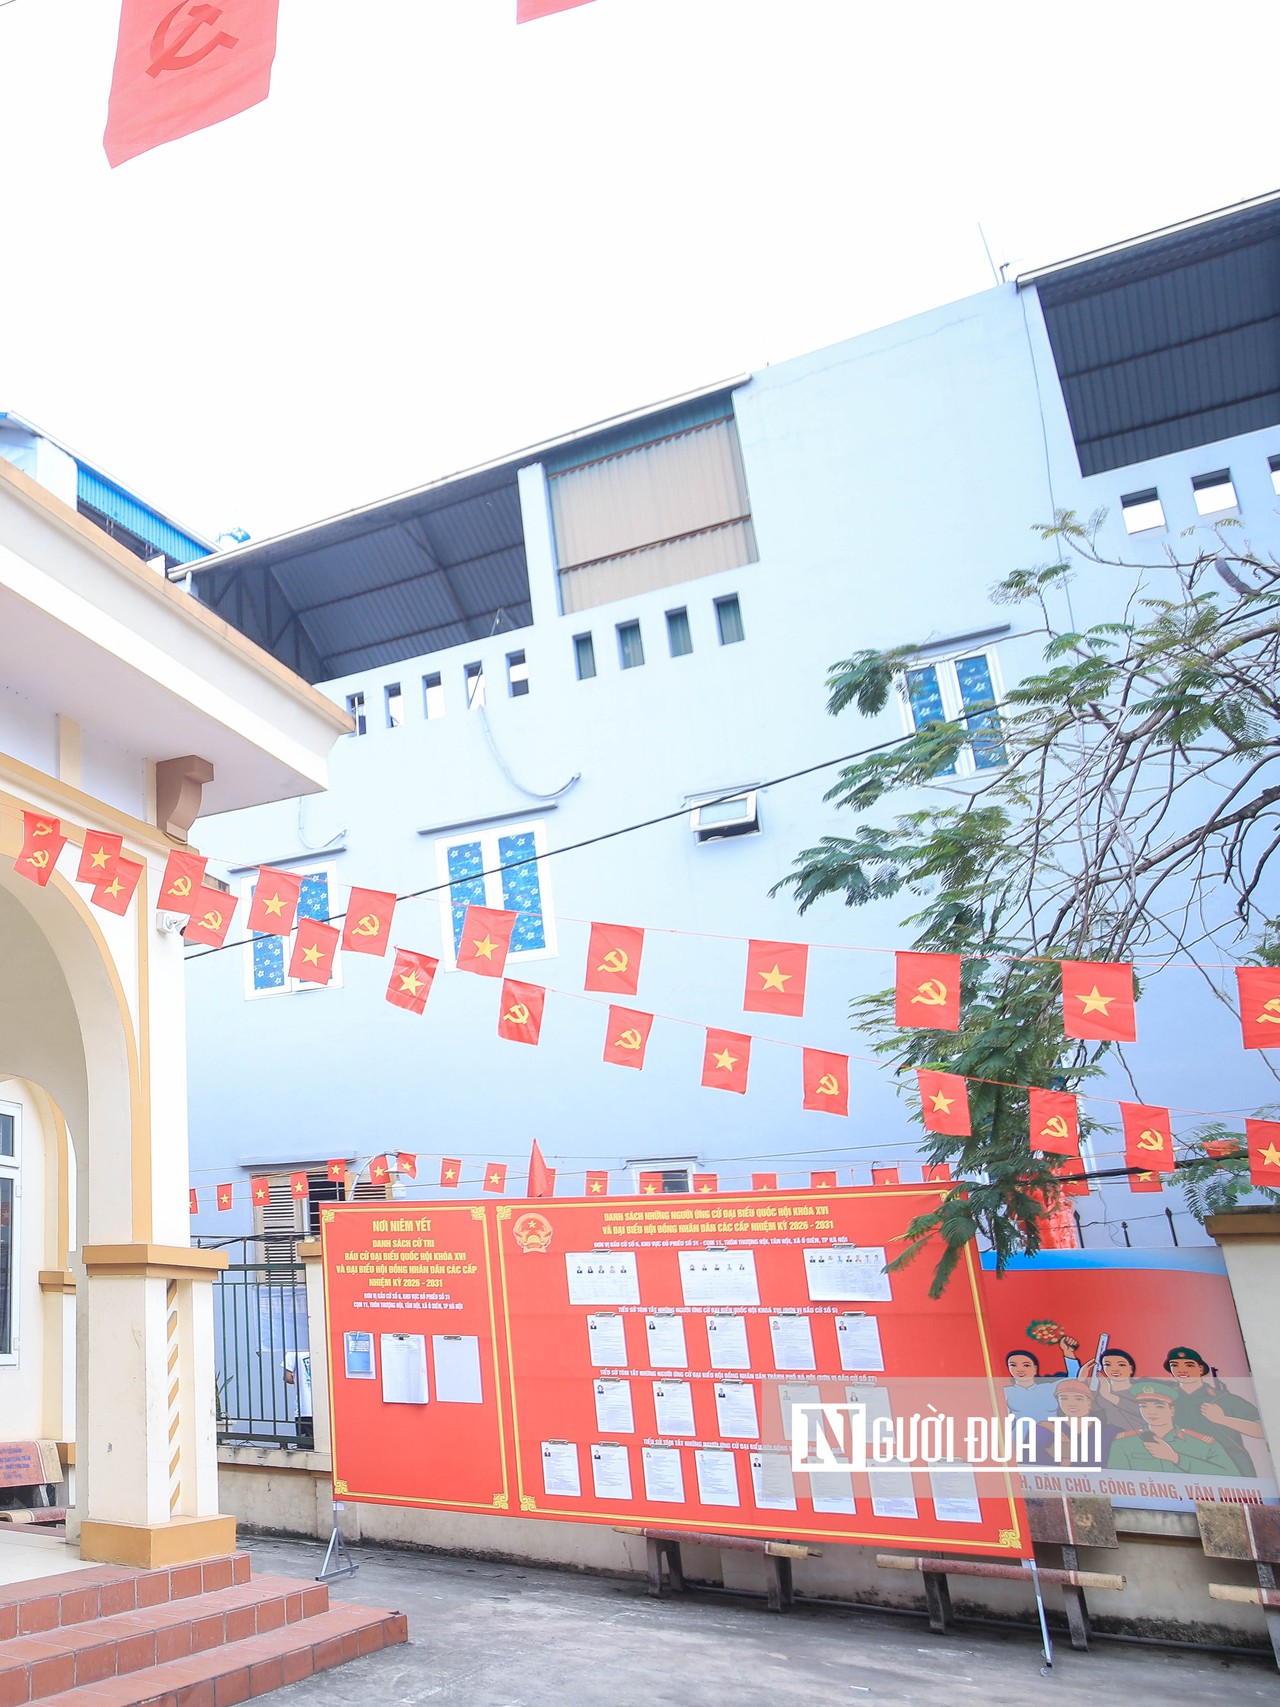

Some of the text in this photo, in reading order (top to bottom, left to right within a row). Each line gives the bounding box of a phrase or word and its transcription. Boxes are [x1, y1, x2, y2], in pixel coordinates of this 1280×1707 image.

[372, 1216, 431, 1232] NƠI NIÊM YẾT
[372, 1237, 435, 1248] DANH SÁCH CỬ TRI
[1035, 1474, 1062, 1492] DÂN
[1065, 1474, 1096, 1494] CHỦ,
[1099, 1478, 1136, 1497] CÔNG
[1139, 1477, 1183, 1501] BẰNG,
[1184, 1482, 1215, 1502] VĂN
[1217, 1486, 1264, 1505] MINH!
